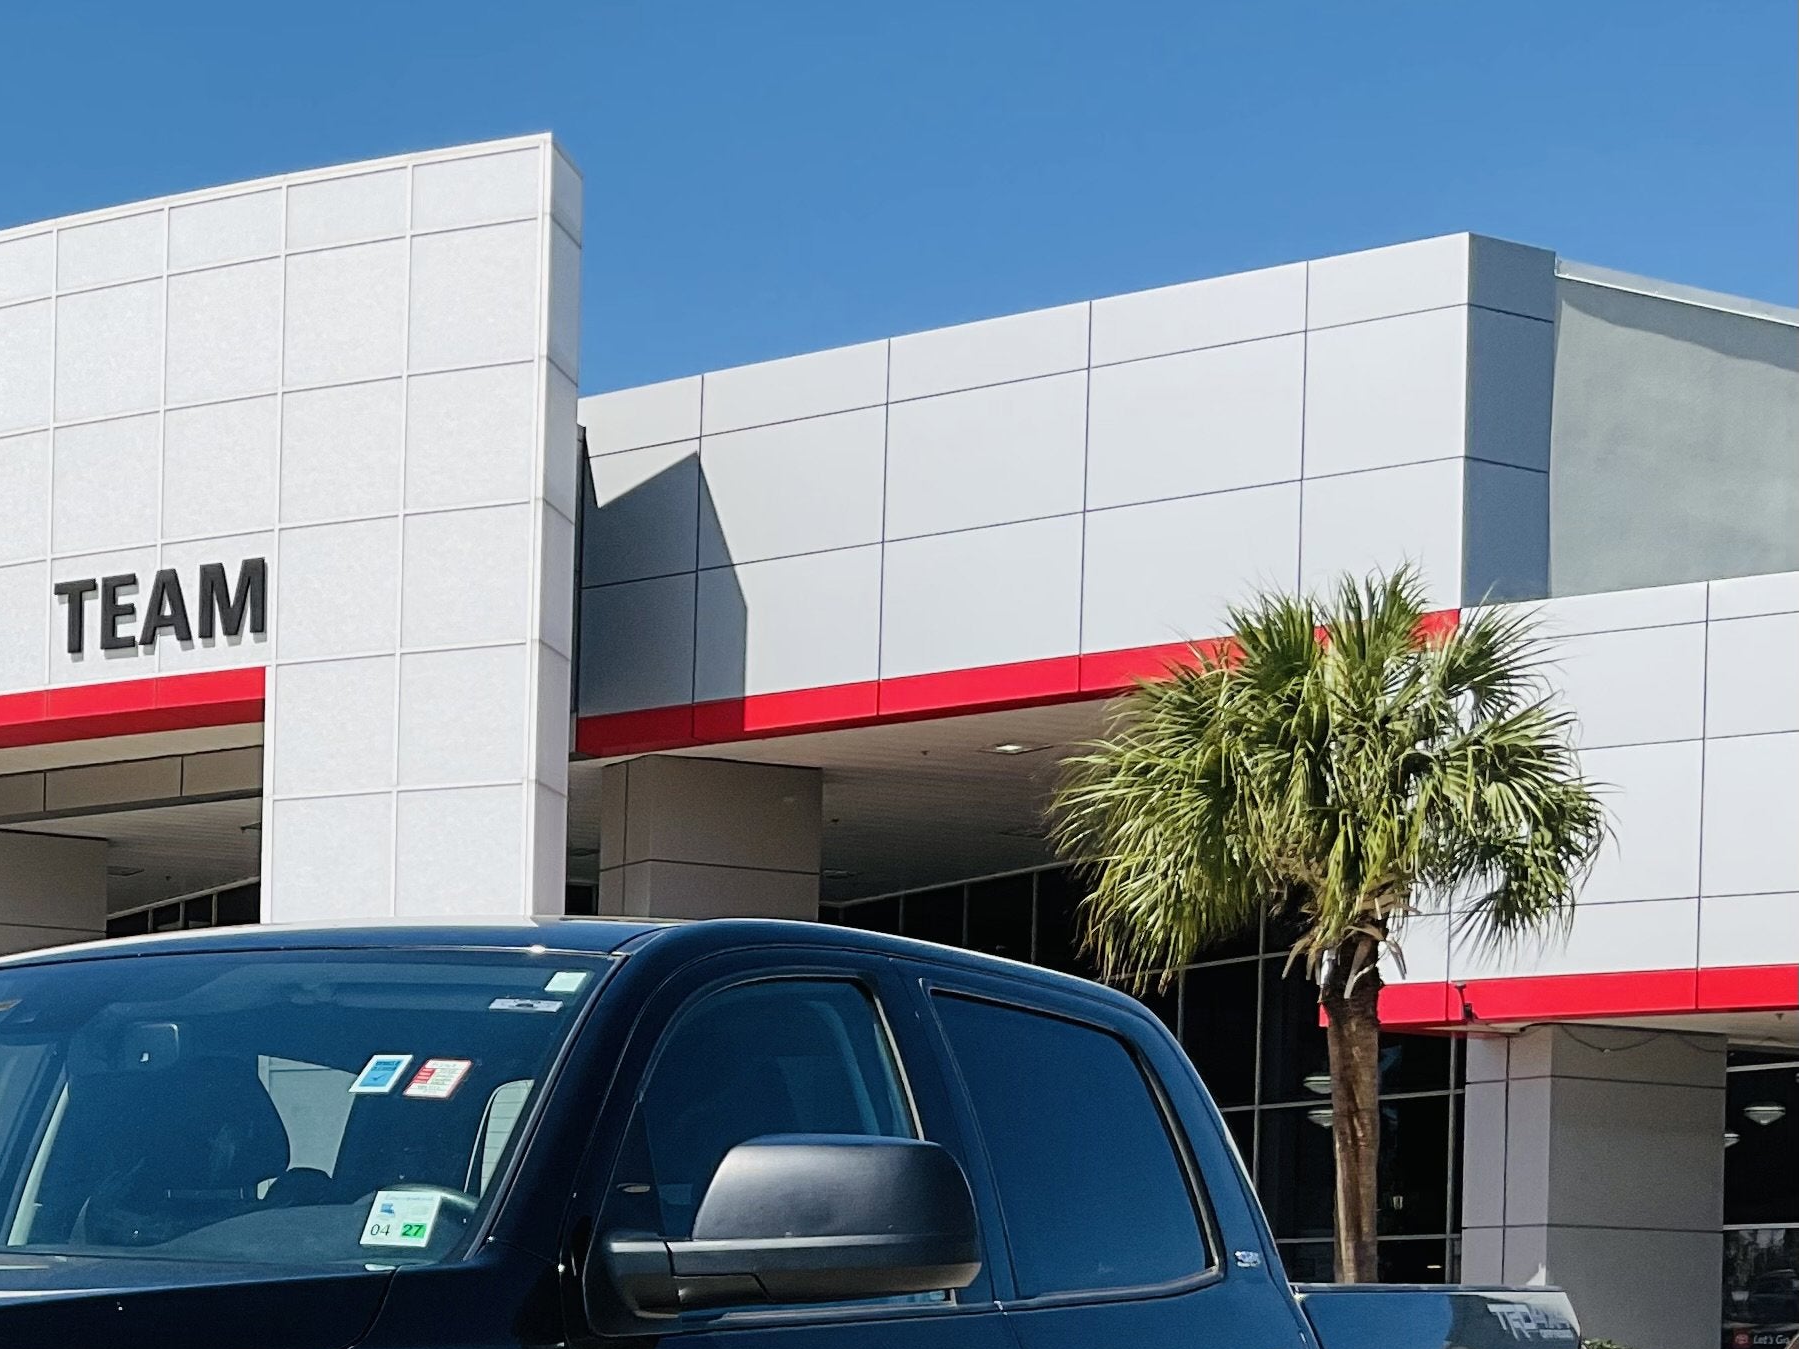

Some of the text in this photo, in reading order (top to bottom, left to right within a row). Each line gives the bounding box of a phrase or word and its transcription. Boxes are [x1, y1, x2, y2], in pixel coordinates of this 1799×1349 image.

[53, 557, 266, 654] TEAM
[370, 1223, 423, 1237] 04 27
